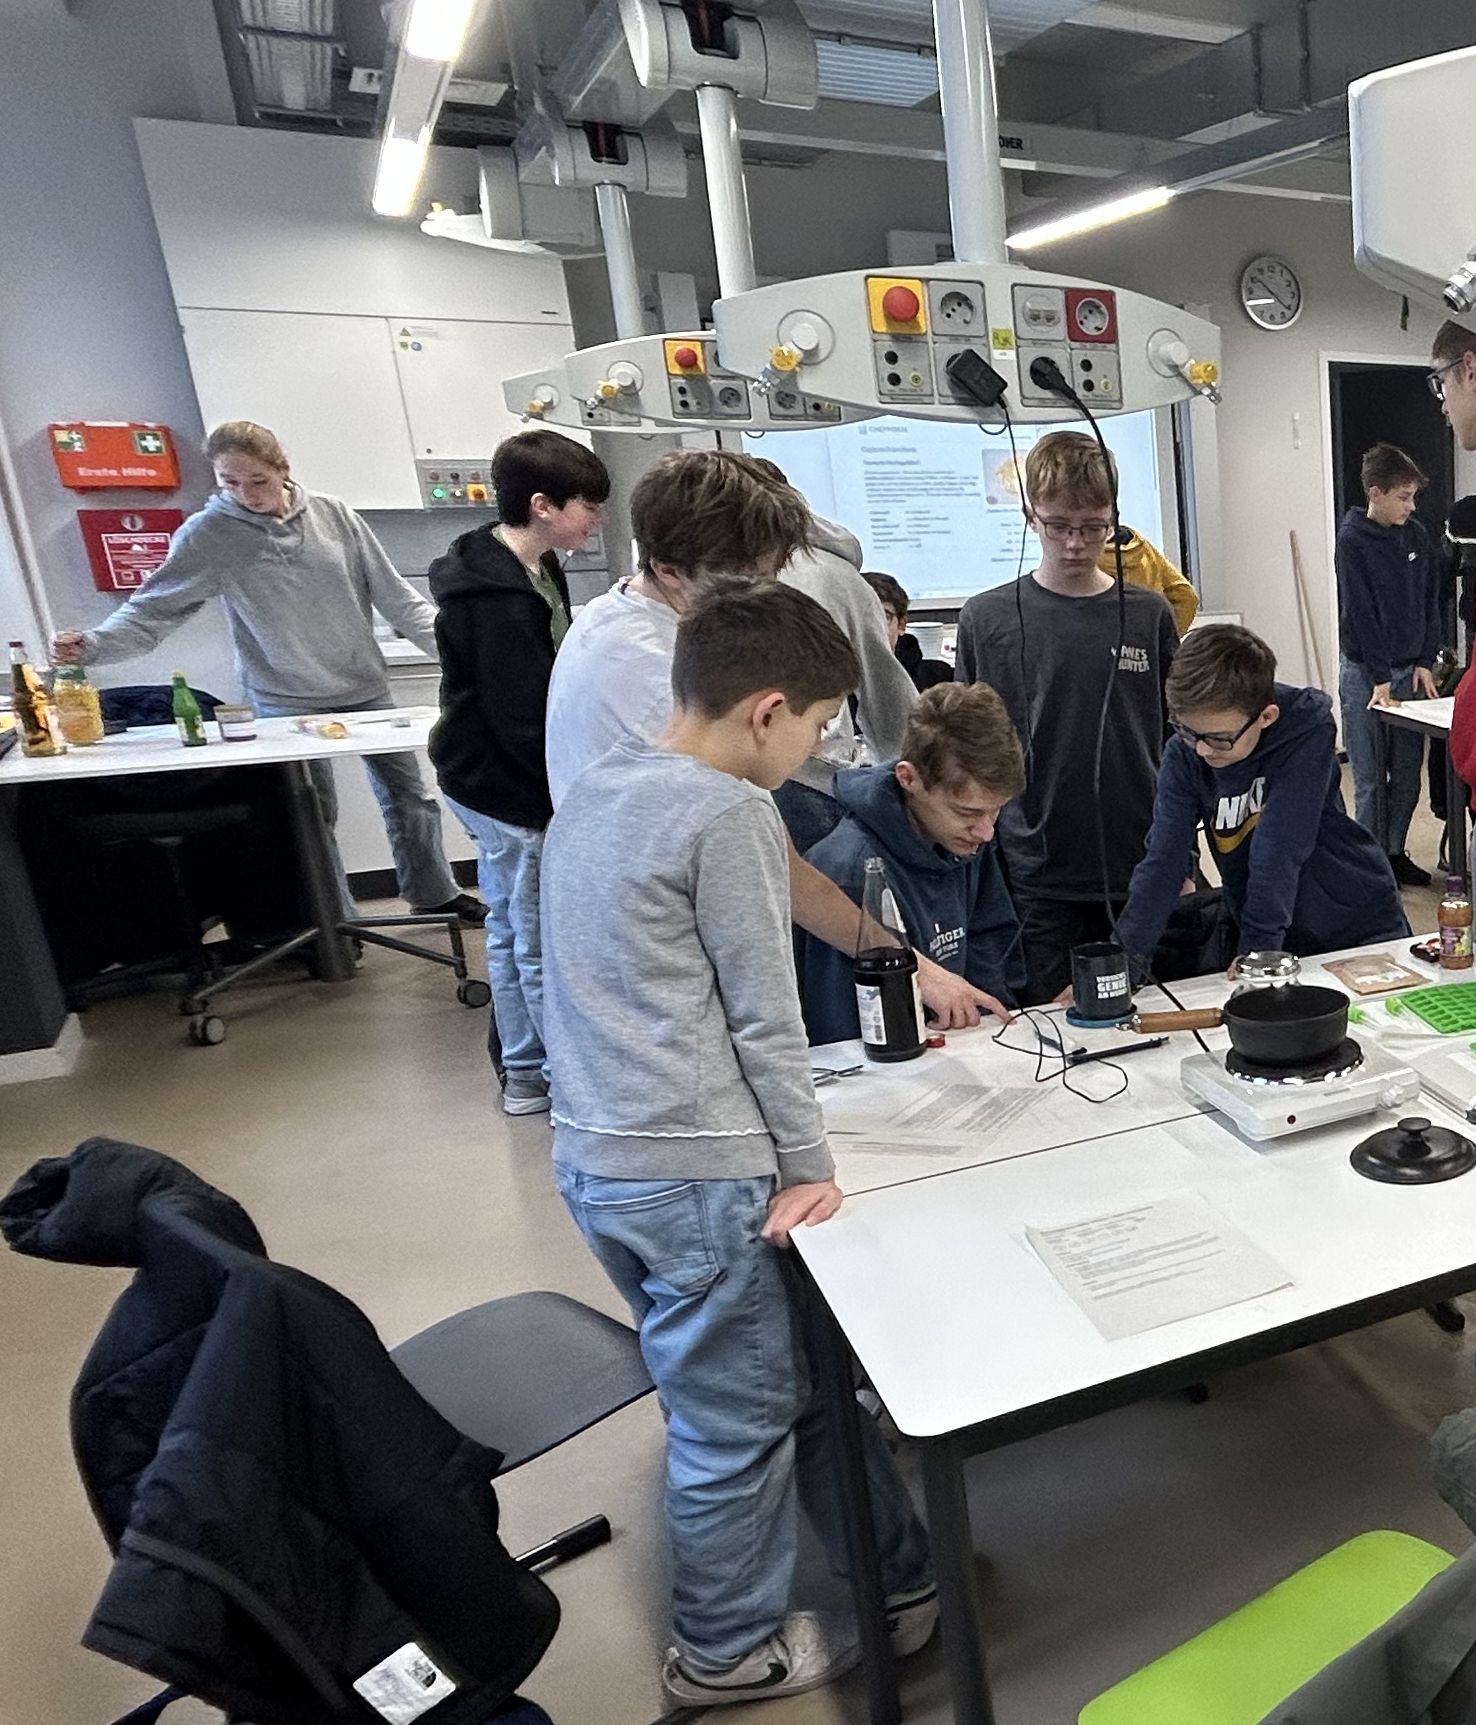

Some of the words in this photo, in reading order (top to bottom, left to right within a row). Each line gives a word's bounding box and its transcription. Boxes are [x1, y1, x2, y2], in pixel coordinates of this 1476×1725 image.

[77, 467, 118, 476] Erste
[121, 467, 157, 476] Hilfe
[1215, 776, 1266, 830] NIK
[1097, 977, 1127, 992] GENIE
